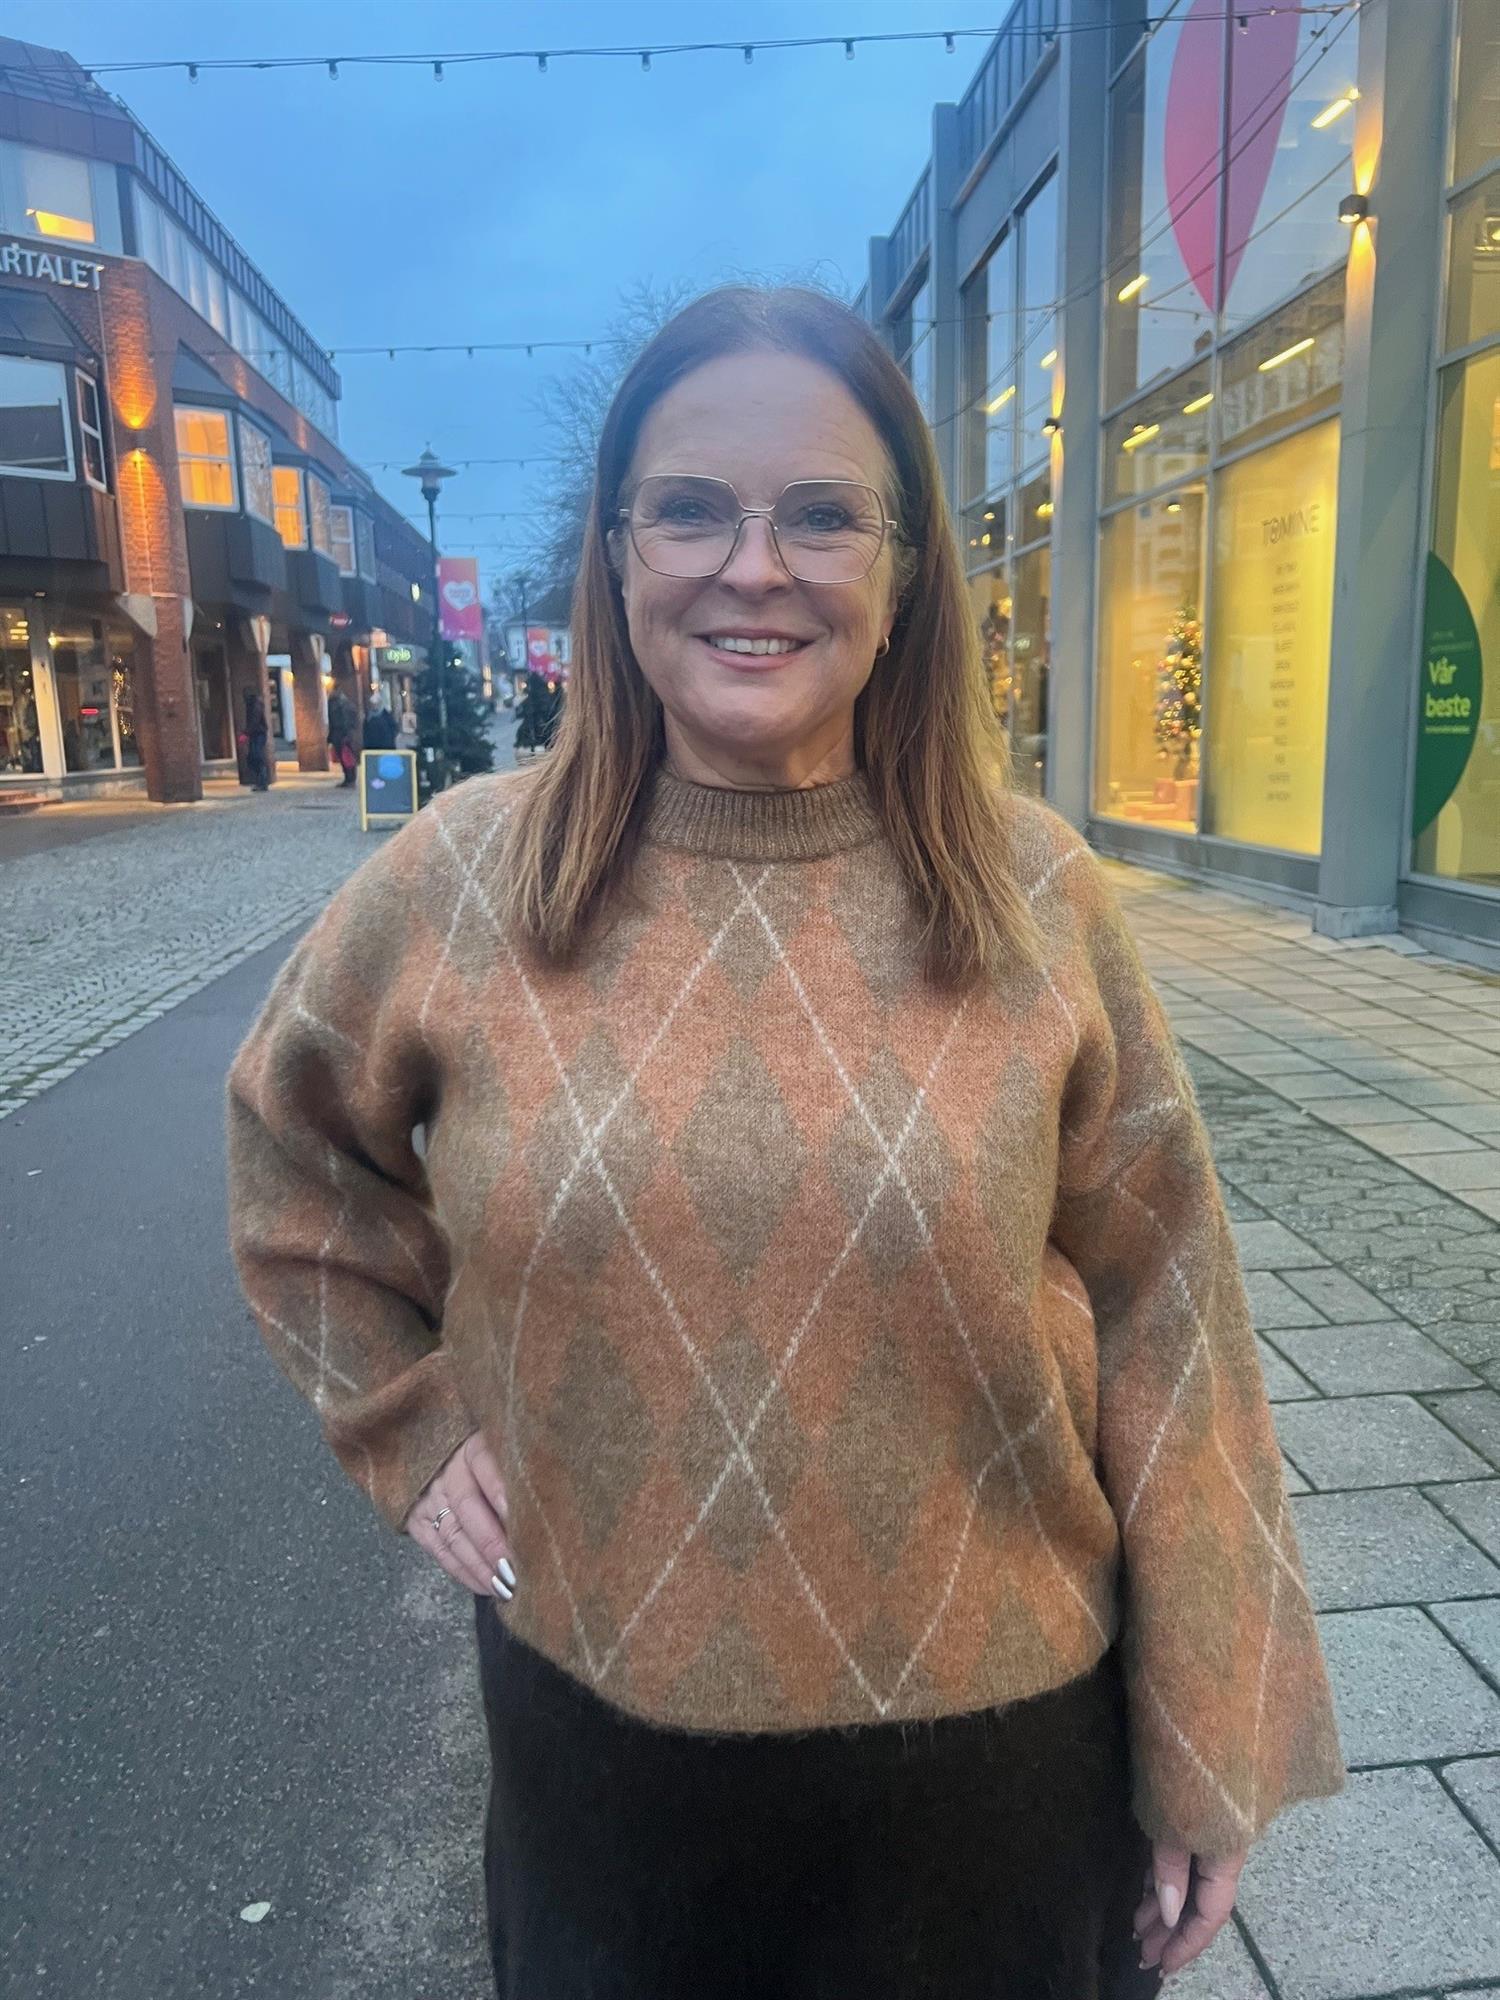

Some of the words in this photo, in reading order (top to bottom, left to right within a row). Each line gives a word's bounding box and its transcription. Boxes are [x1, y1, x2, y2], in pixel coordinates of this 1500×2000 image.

[0, 246, 105, 291] RTALET
[1428, 655, 1457, 686] Vår
[1425, 692, 1472, 718] beste
